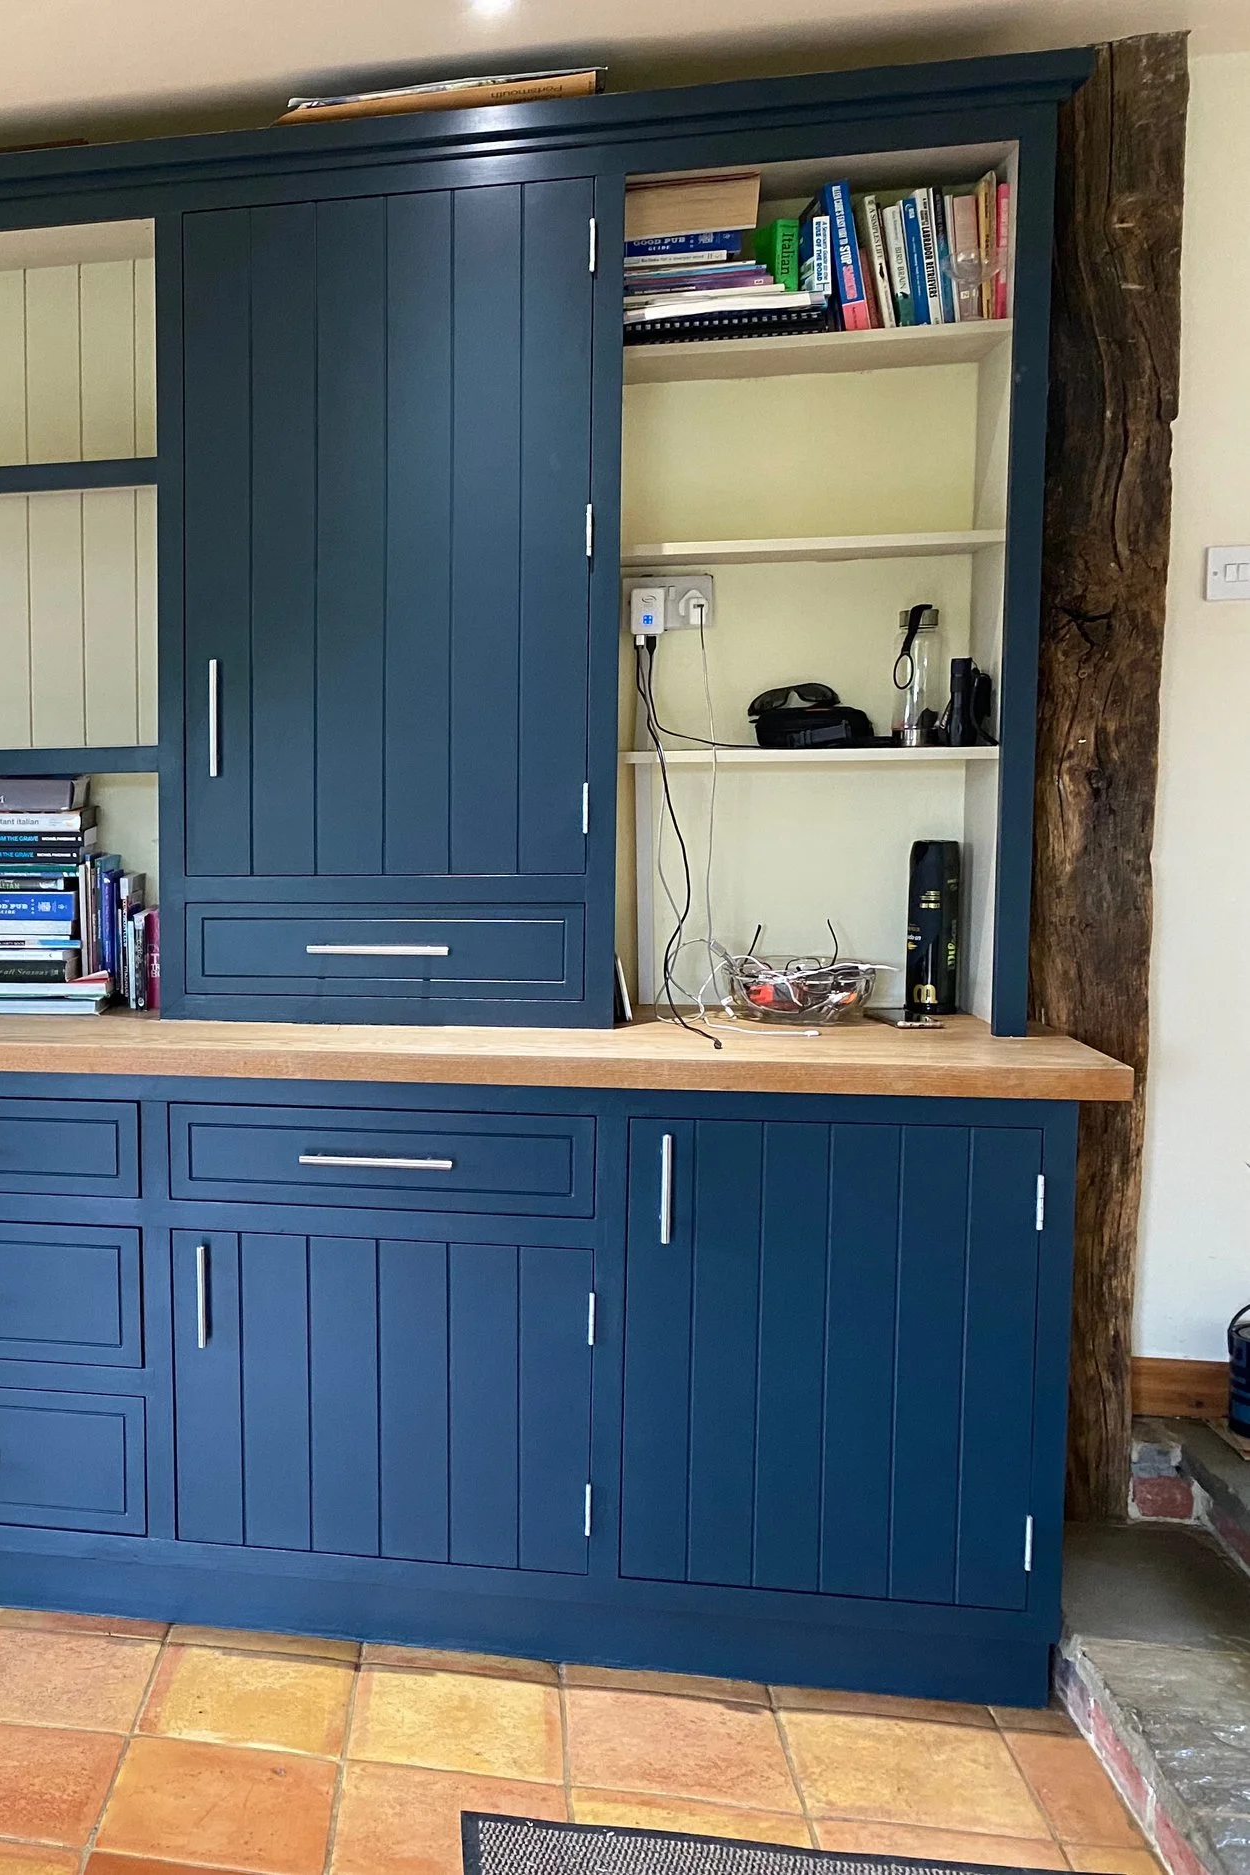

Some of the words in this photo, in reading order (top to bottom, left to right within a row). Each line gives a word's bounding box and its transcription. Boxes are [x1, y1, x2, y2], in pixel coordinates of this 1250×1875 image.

[491, 85, 562, 98] Portsmouth
[870, 214, 881, 244] SIMPLES
[816, 238, 821, 247] OF
[875, 245, 883, 260] LIFE
[922, 227, 933, 260] LABRADOR
[781, 232, 794, 275] Italian
[839, 245, 852, 264] STOP
[895, 247, 903, 265] BIRD
[898, 266, 906, 289] BRAIN
[925, 262, 937, 298] RETRIEVERS
